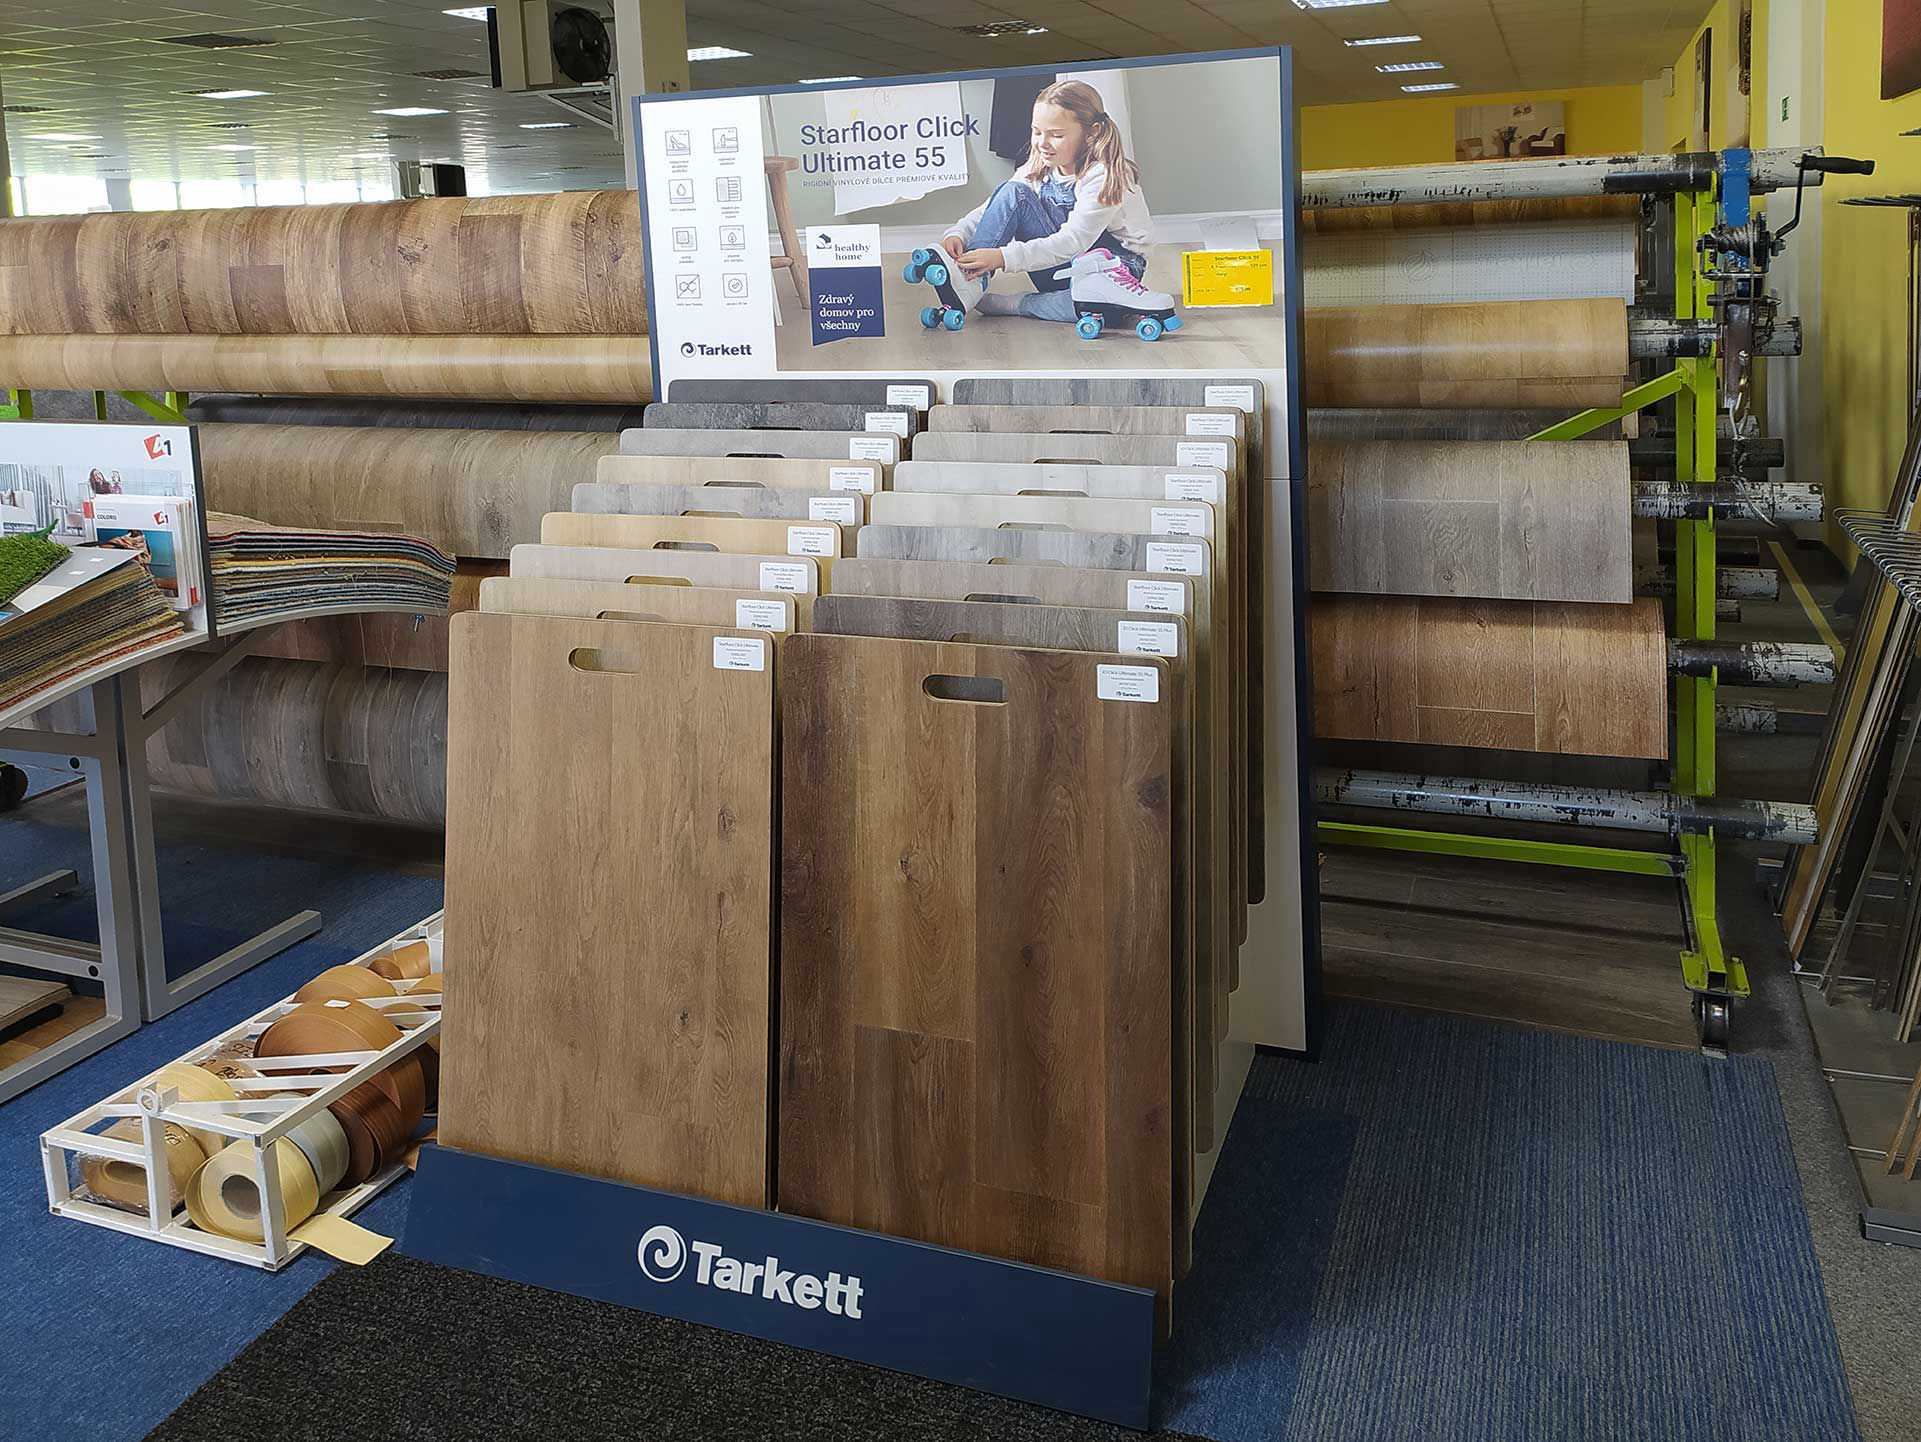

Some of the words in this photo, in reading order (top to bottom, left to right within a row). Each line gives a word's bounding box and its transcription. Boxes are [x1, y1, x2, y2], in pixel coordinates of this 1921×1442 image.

[800, 120, 908, 146] Starfloor
[916, 114, 980, 139] Click
[802, 150, 906, 174] Ultimate
[915, 146, 946, 168] 55
[834, 243, 871, 253] healthy
[835, 252, 863, 261] home
[818, 293, 855, 306] Zdravý
[820, 307, 854, 317] domov
[856, 308, 875, 318] pro
[820, 319, 861, 332] všechny
[697, 344, 752, 356] Tarkett
[691, 1240, 864, 1320] Tarkett
